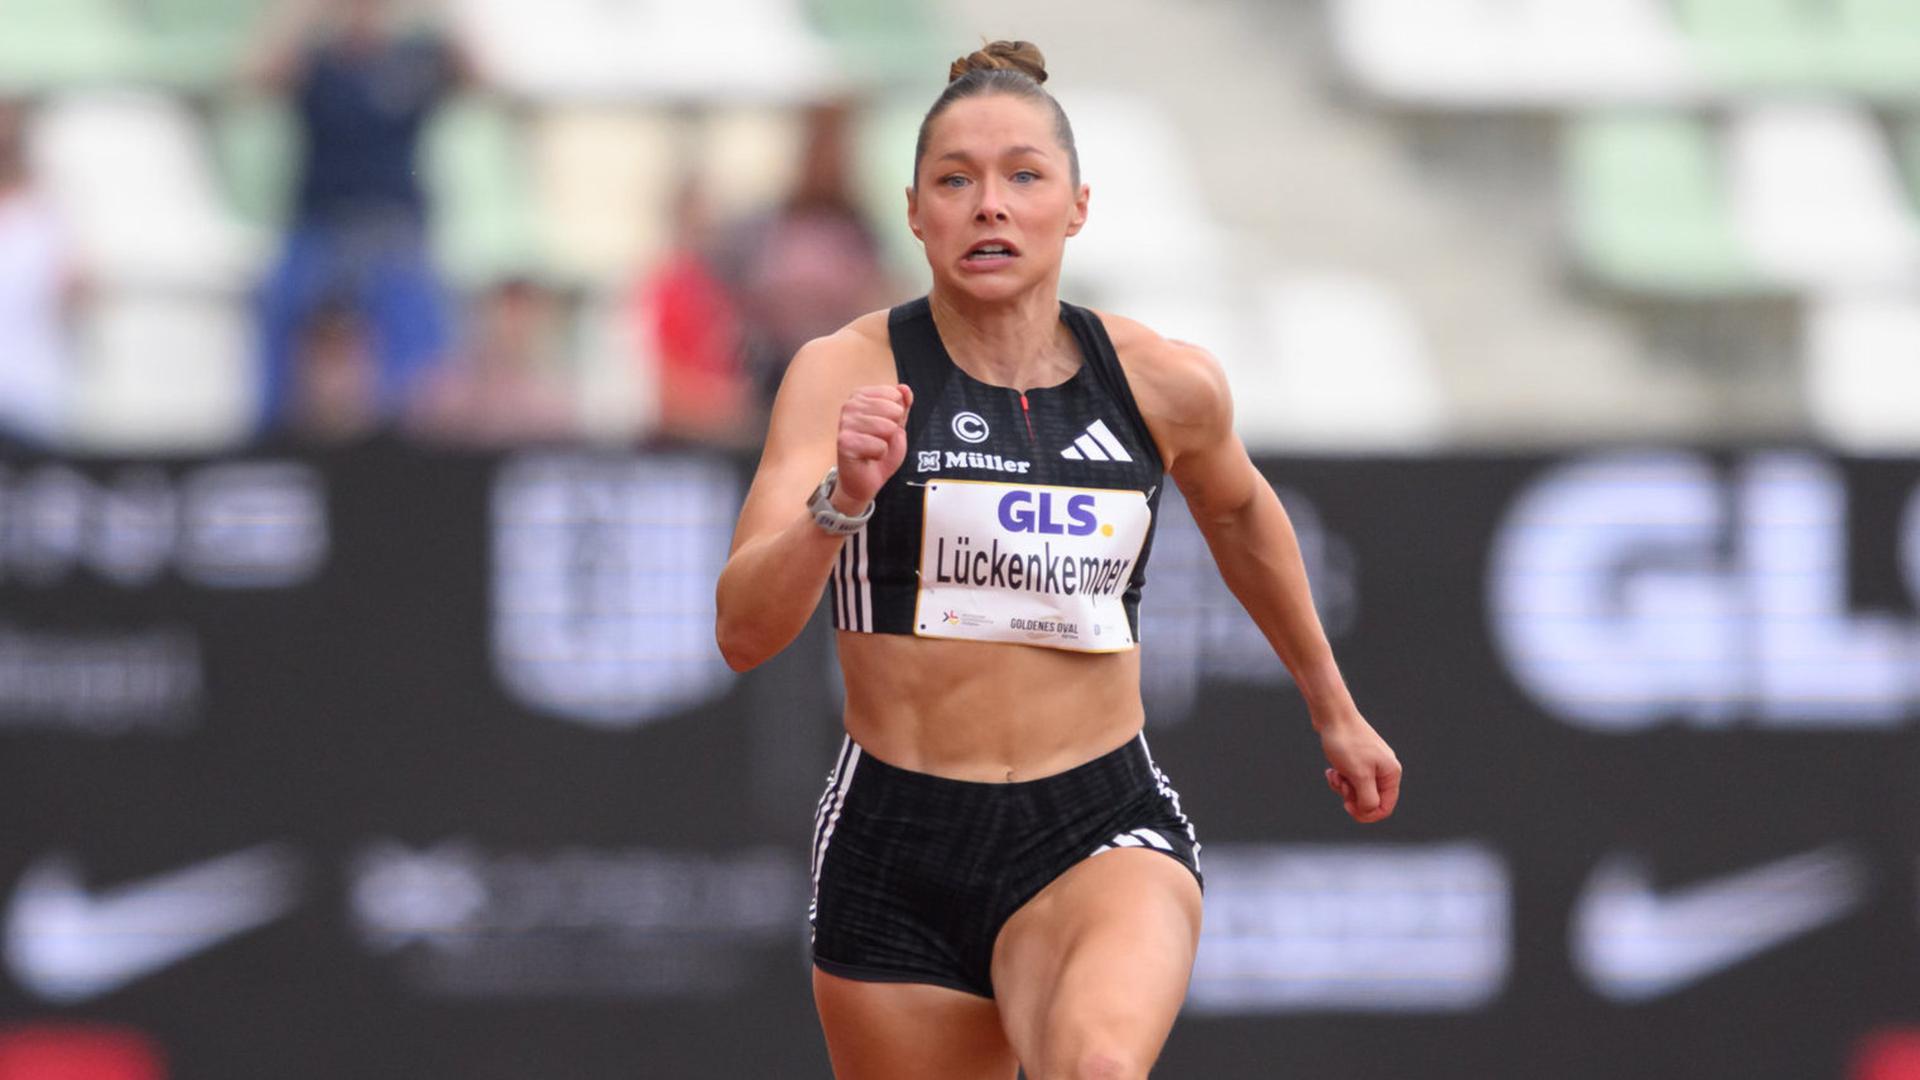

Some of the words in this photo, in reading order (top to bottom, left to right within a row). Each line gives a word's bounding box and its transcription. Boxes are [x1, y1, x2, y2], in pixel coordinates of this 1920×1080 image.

[945, 451, 1031, 473] Müller
[936, 537, 1130, 608] Lückenkemper
[1486, 455, 1920, 728] GL
[1010, 618, 1055, 632] GOLDENES
[1057, 622, 1079, 634] OVAL
